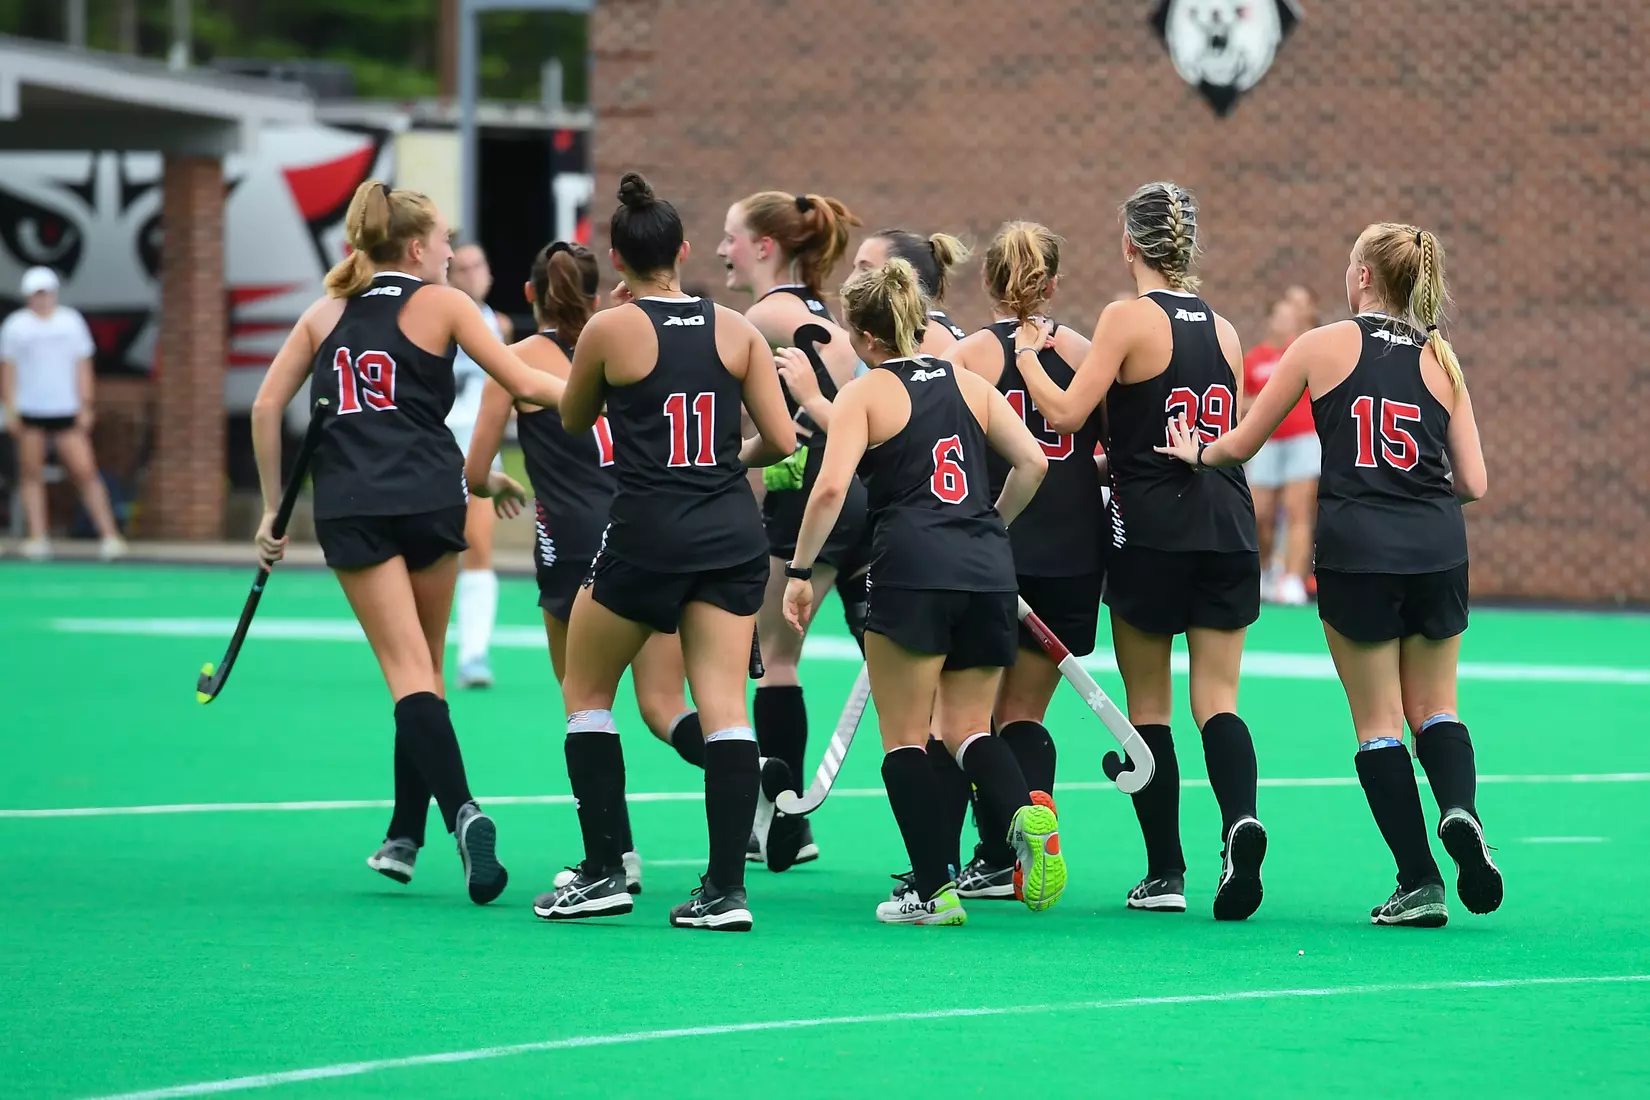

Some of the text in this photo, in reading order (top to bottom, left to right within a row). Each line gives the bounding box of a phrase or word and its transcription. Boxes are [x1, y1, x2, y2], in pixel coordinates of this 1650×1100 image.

[663, 315, 705, 326] A10
[1174, 308, 1208, 322] A10
[333, 346, 398, 415] 19
[663, 391, 717, 468] 11
[1350, 395, 1421, 472] 15
[930, 434, 969, 505] 6
